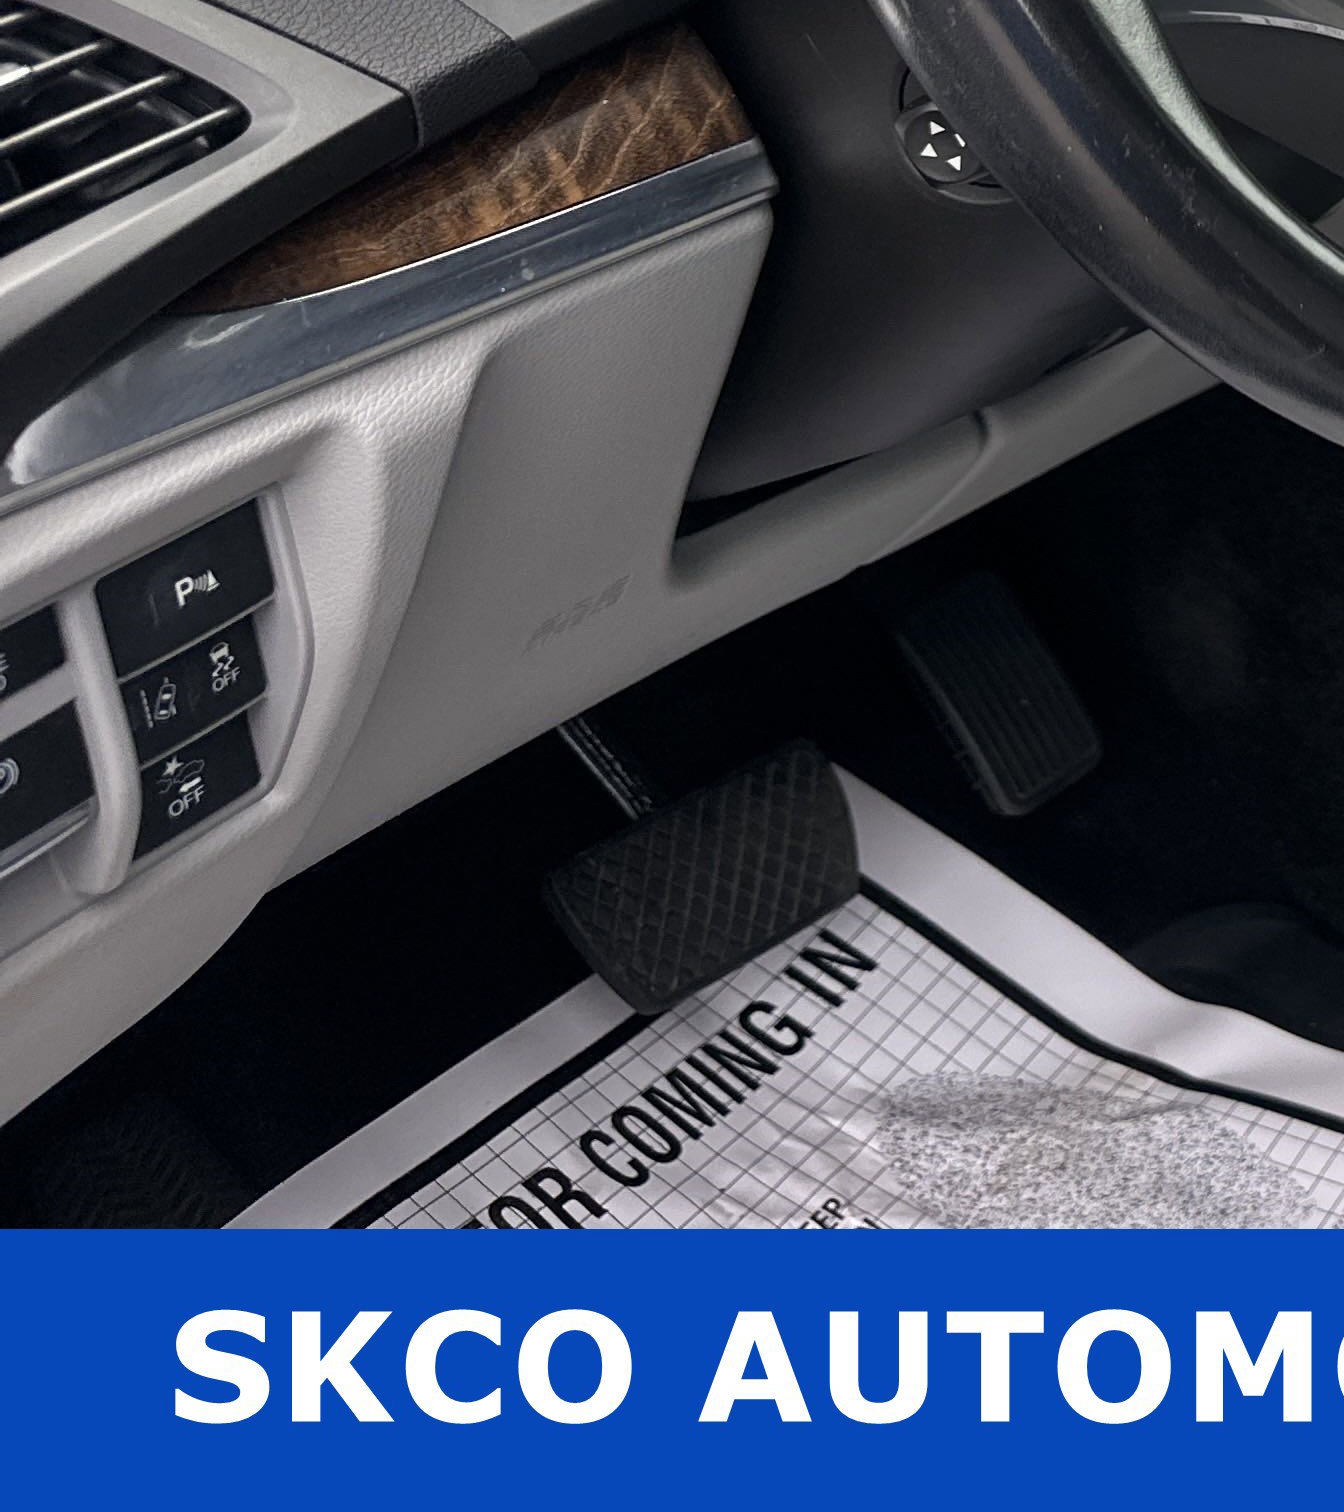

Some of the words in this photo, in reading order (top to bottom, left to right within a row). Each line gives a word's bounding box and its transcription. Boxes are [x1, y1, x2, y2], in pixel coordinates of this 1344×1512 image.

[211, 666, 241, 693] OFF
[168, 785, 205, 816] OFF
[460, 1167, 609, 1229] OR
[579, 999, 816, 1188] COMING
[785, 928, 879, 1008] IN
